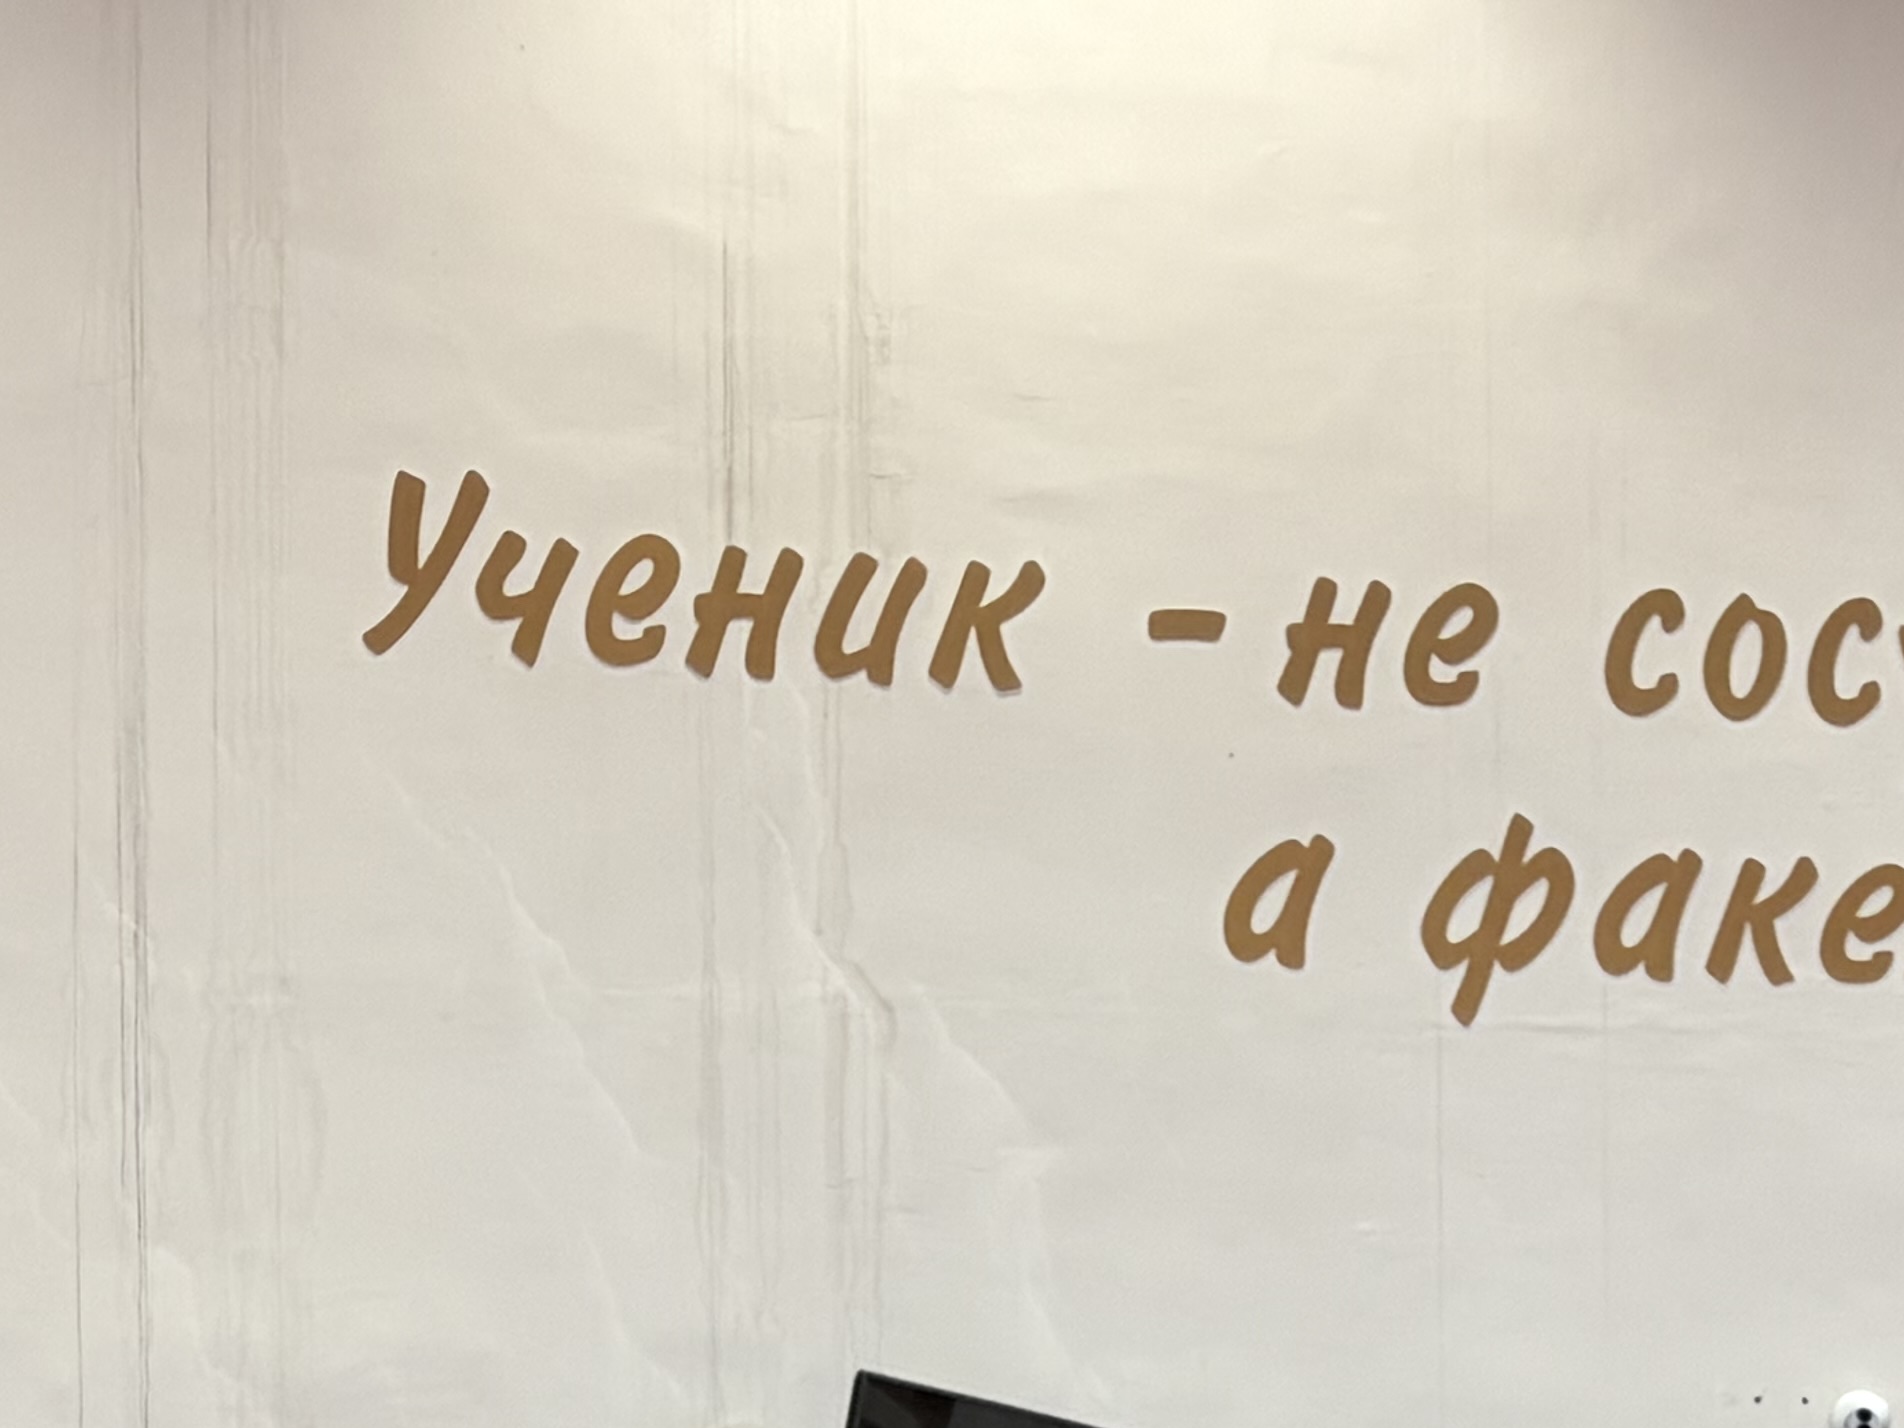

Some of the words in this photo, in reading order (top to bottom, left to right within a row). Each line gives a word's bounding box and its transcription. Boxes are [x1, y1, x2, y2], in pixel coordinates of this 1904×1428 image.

[365, 472, 1044, 688] Ученик
[1279, 579, 1497, 707] не
[1225, 836, 1333, 967] а
